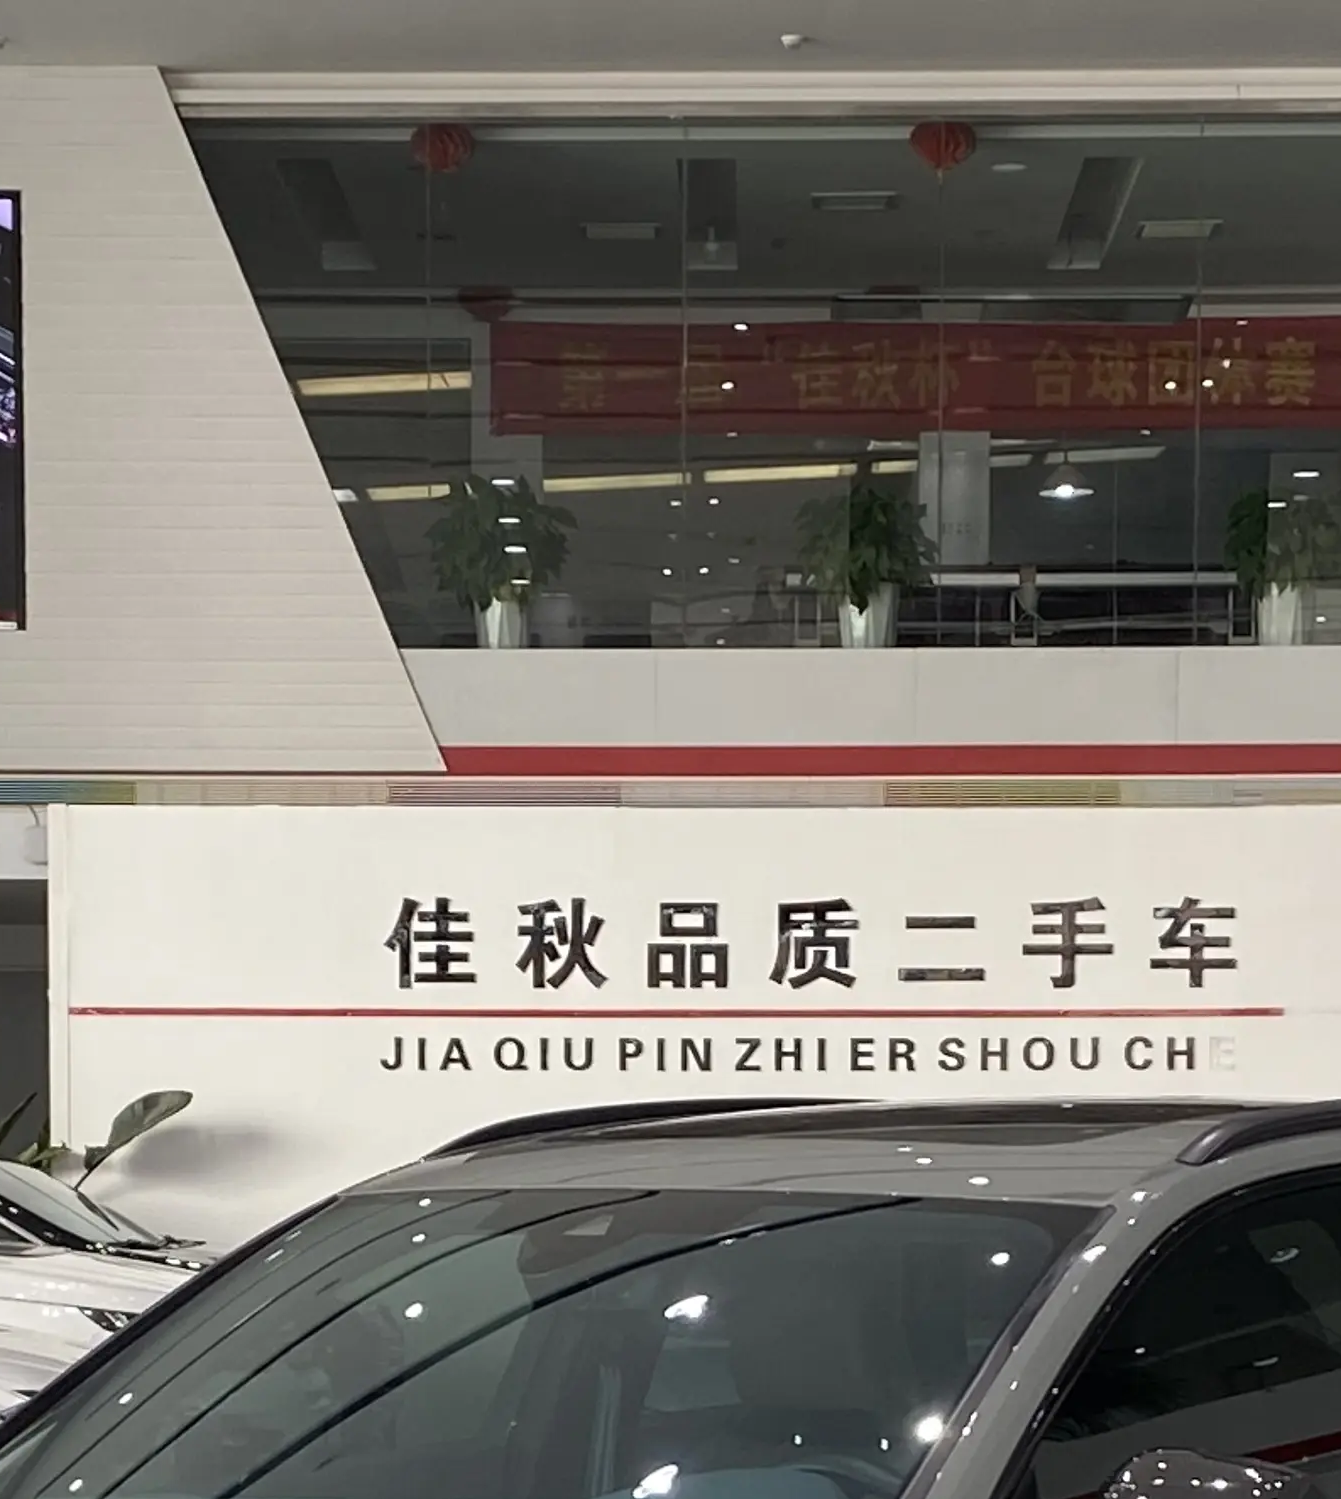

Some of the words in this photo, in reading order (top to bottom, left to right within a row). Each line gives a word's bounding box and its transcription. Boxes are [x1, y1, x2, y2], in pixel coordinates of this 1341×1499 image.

[383, 896, 1238, 989] 佳秋品质二手车
[380, 1036, 473, 1072] JIA
[493, 1036, 595, 1072] QIU
[618, 1036, 713, 1072] PIN
[734, 1036, 828, 1072] ZHI
[849, 1036, 917, 1072] ER
[937, 1036, 1101, 1072] SHOU
